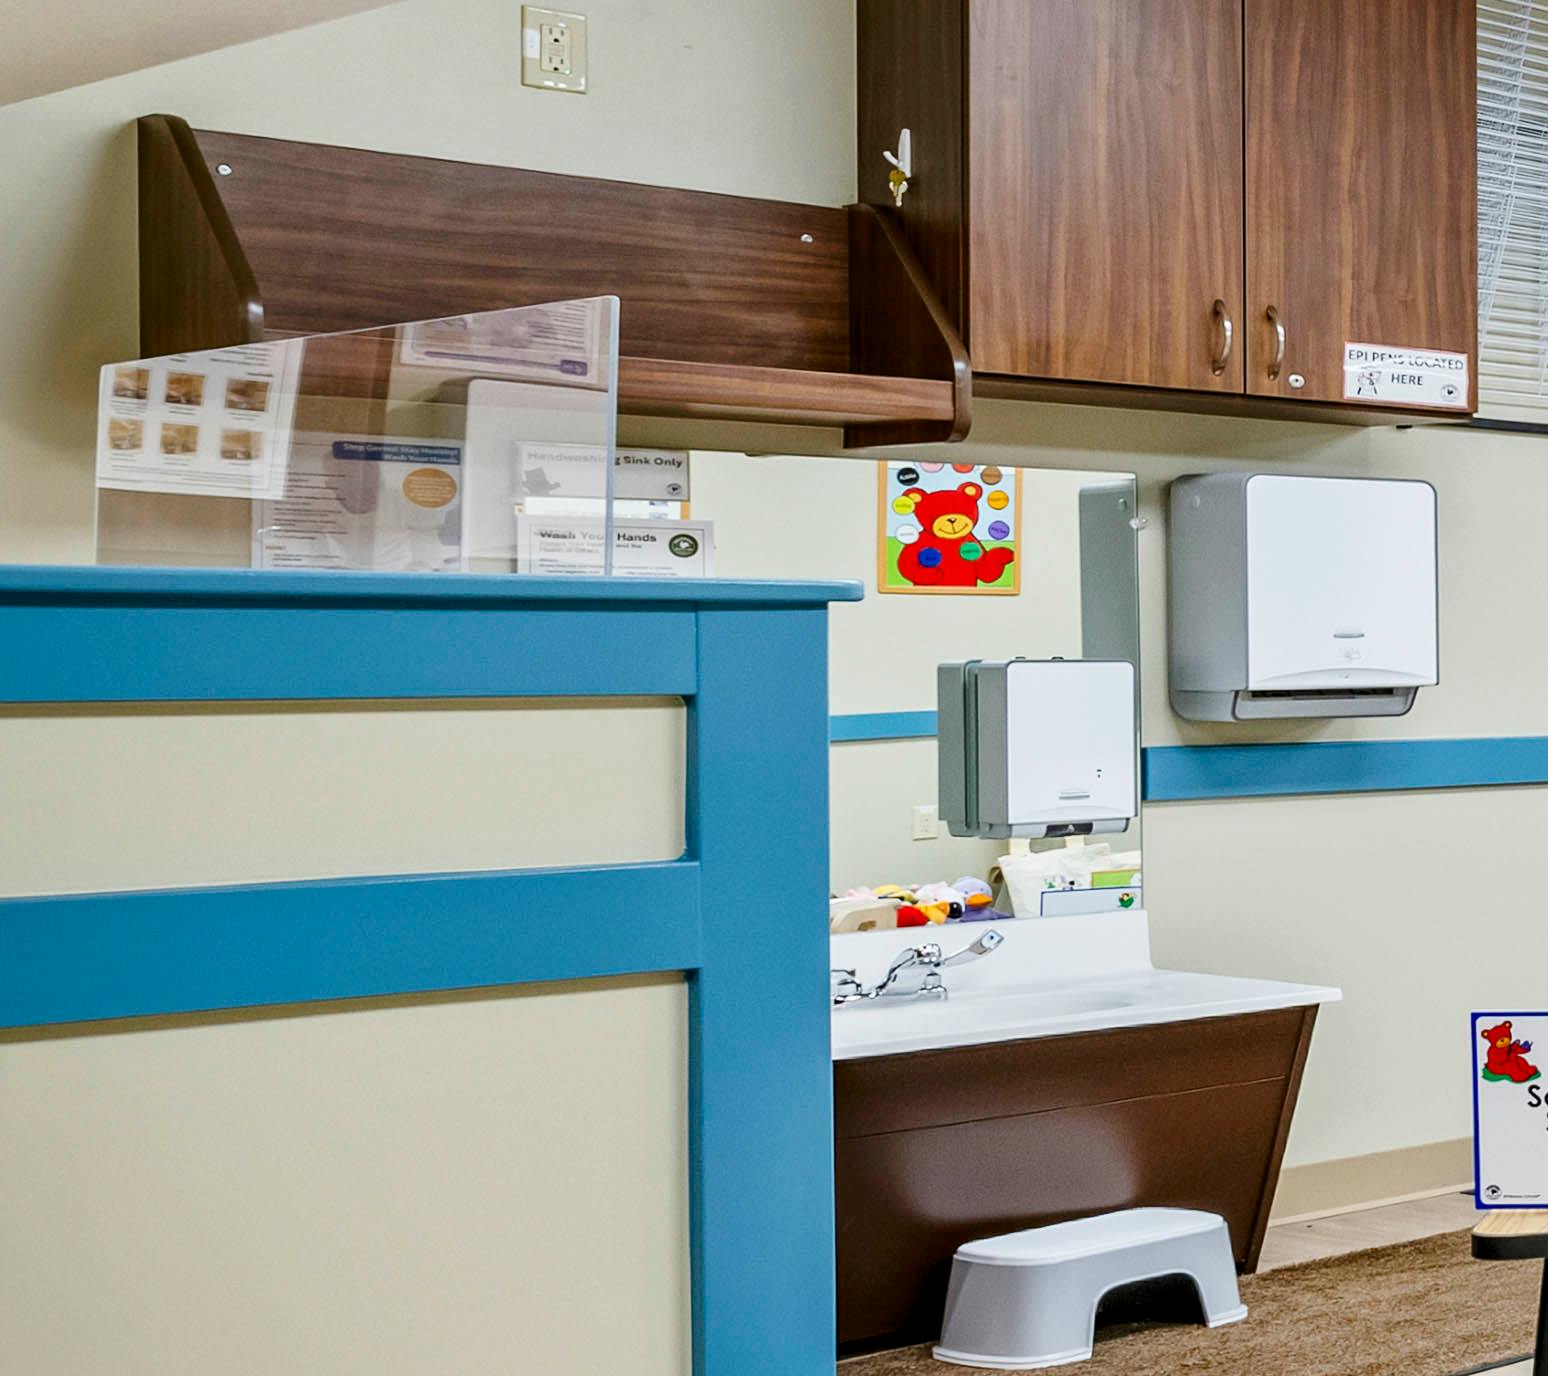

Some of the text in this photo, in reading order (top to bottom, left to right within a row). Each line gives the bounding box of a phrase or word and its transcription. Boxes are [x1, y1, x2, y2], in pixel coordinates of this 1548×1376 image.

[1349, 349, 1465, 371] EPI PENS LOCATED
[1391, 373, 1424, 386] HERE
[623, 455, 651, 466] Sink
[653, 456, 683, 469] Only
[616, 532, 657, 543] Hands
